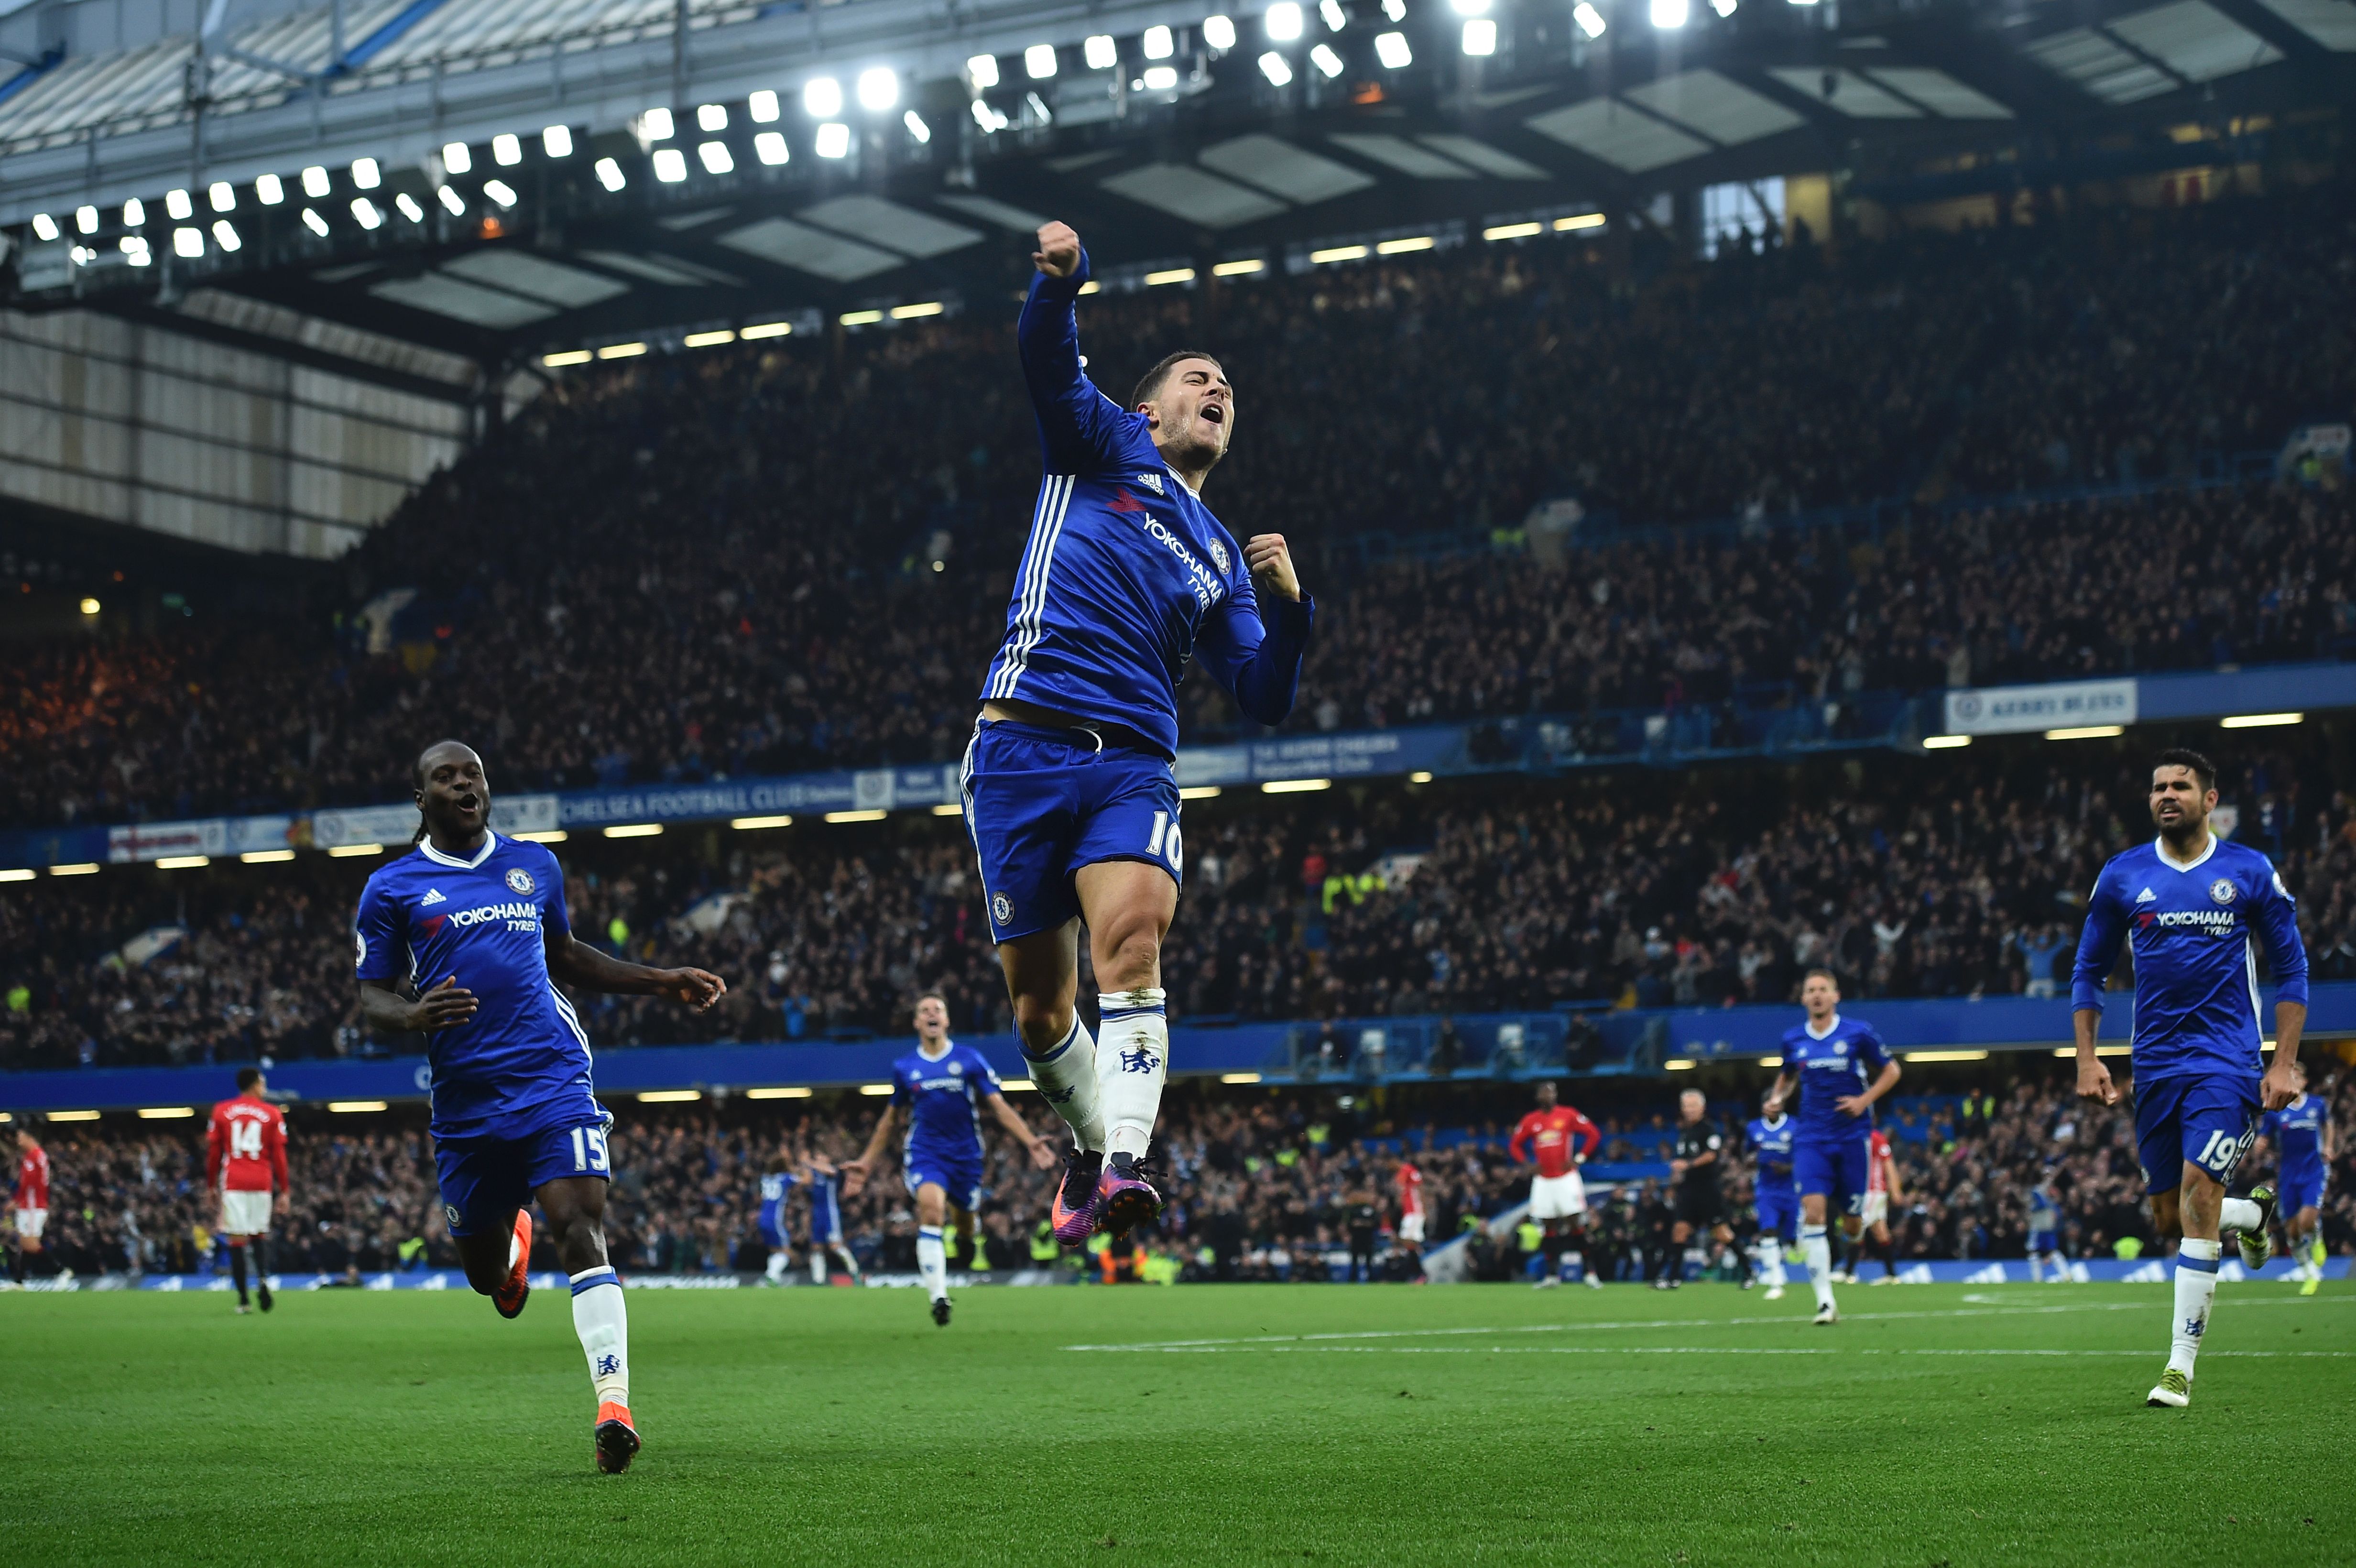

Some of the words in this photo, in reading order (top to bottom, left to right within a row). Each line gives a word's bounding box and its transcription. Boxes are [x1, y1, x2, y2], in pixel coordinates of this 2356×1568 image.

[1137, 474, 1165, 496] adidas
[1143, 512, 1222, 606] YOKOHAMA
[1187, 575, 1211, 613] TYRE
[647, 787, 748, 817] FOOTBALL
[753, 782, 807, 810] CLUB
[1145, 811, 1183, 872] 10
[447, 902, 536, 928] YOKOHAMA
[506, 920, 536, 932] TYRES
[2156, 910, 2234, 927] YOKOHAMA
[230, 1119, 263, 1161] 14
[569, 1126, 608, 1171] 15
[2196, 1129, 2237, 1172] 19
